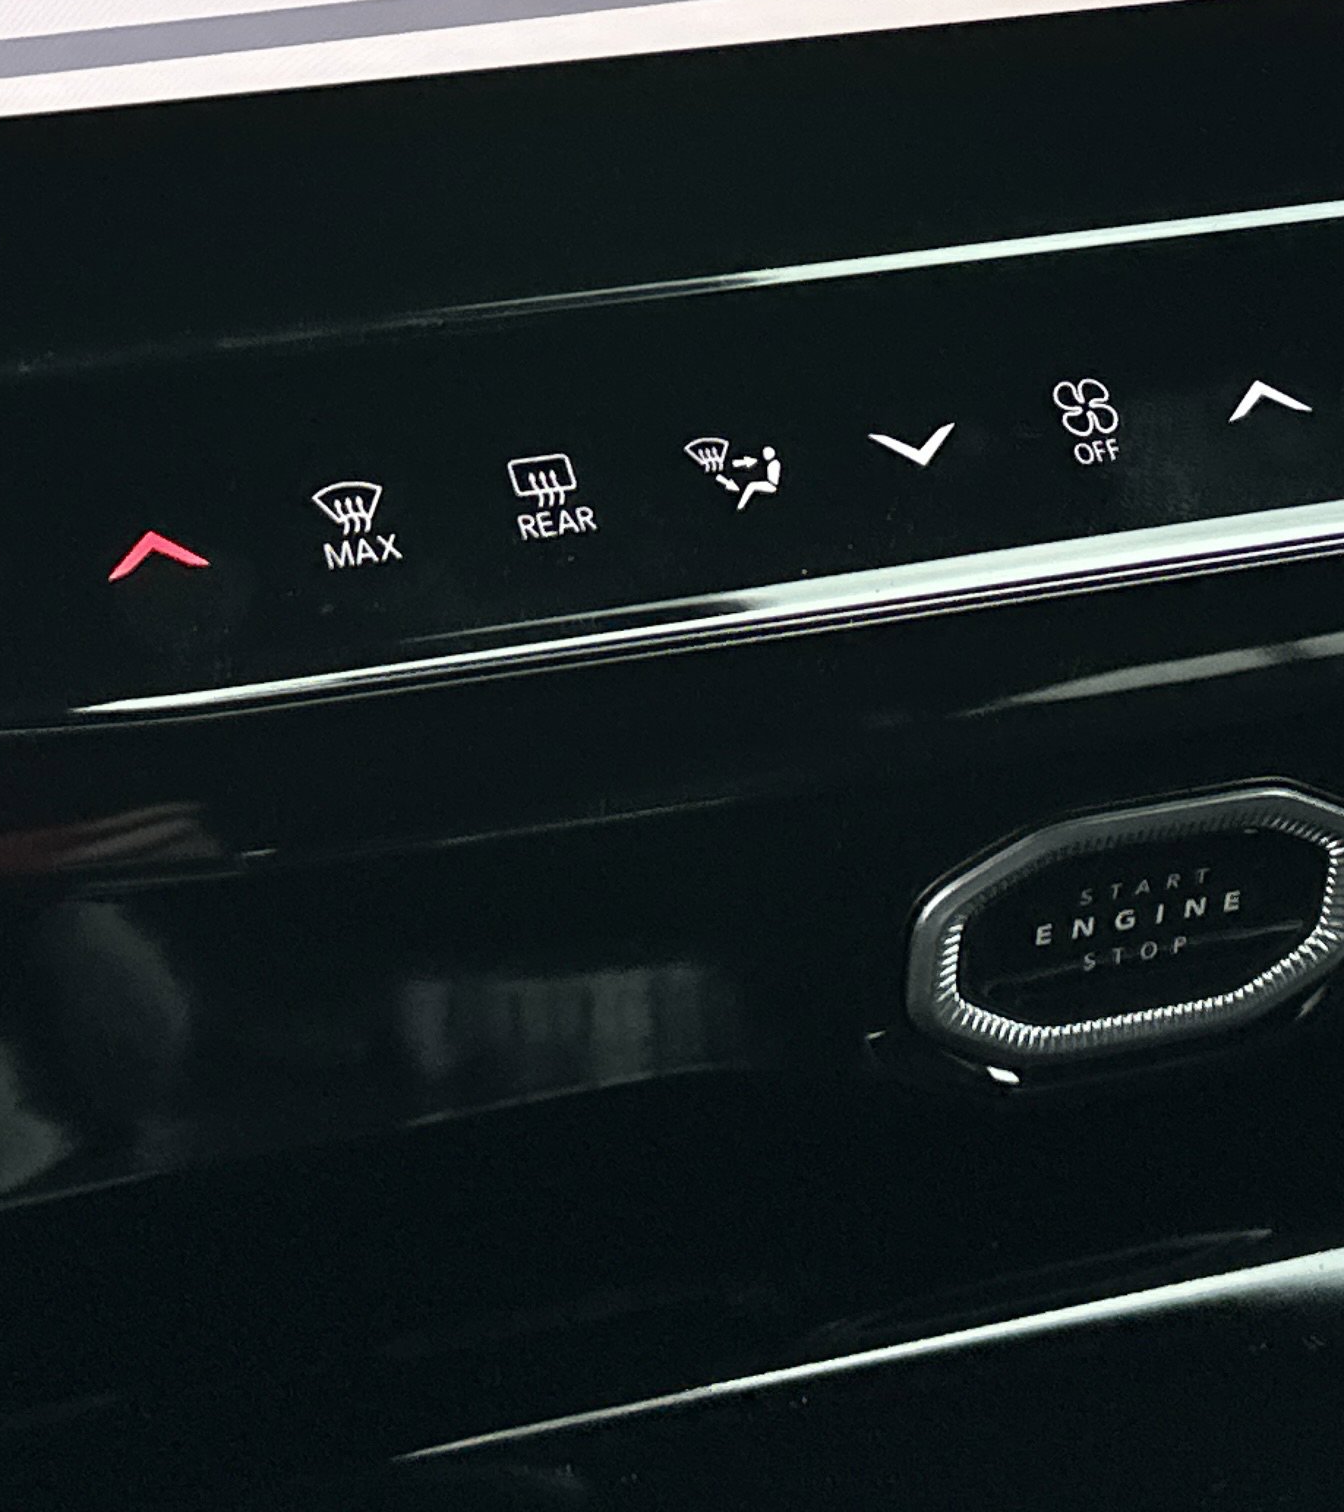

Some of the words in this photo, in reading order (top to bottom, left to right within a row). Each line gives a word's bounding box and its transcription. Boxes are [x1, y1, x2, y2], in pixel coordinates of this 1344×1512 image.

[1072, 438, 1120, 466] OFF
[516, 505, 598, 541] REAR
[323, 532, 404, 570] MAX
[1079, 867, 1210, 907] START
[1035, 890, 1242, 946] ENGINE
[1082, 936, 1188, 972] STOP
